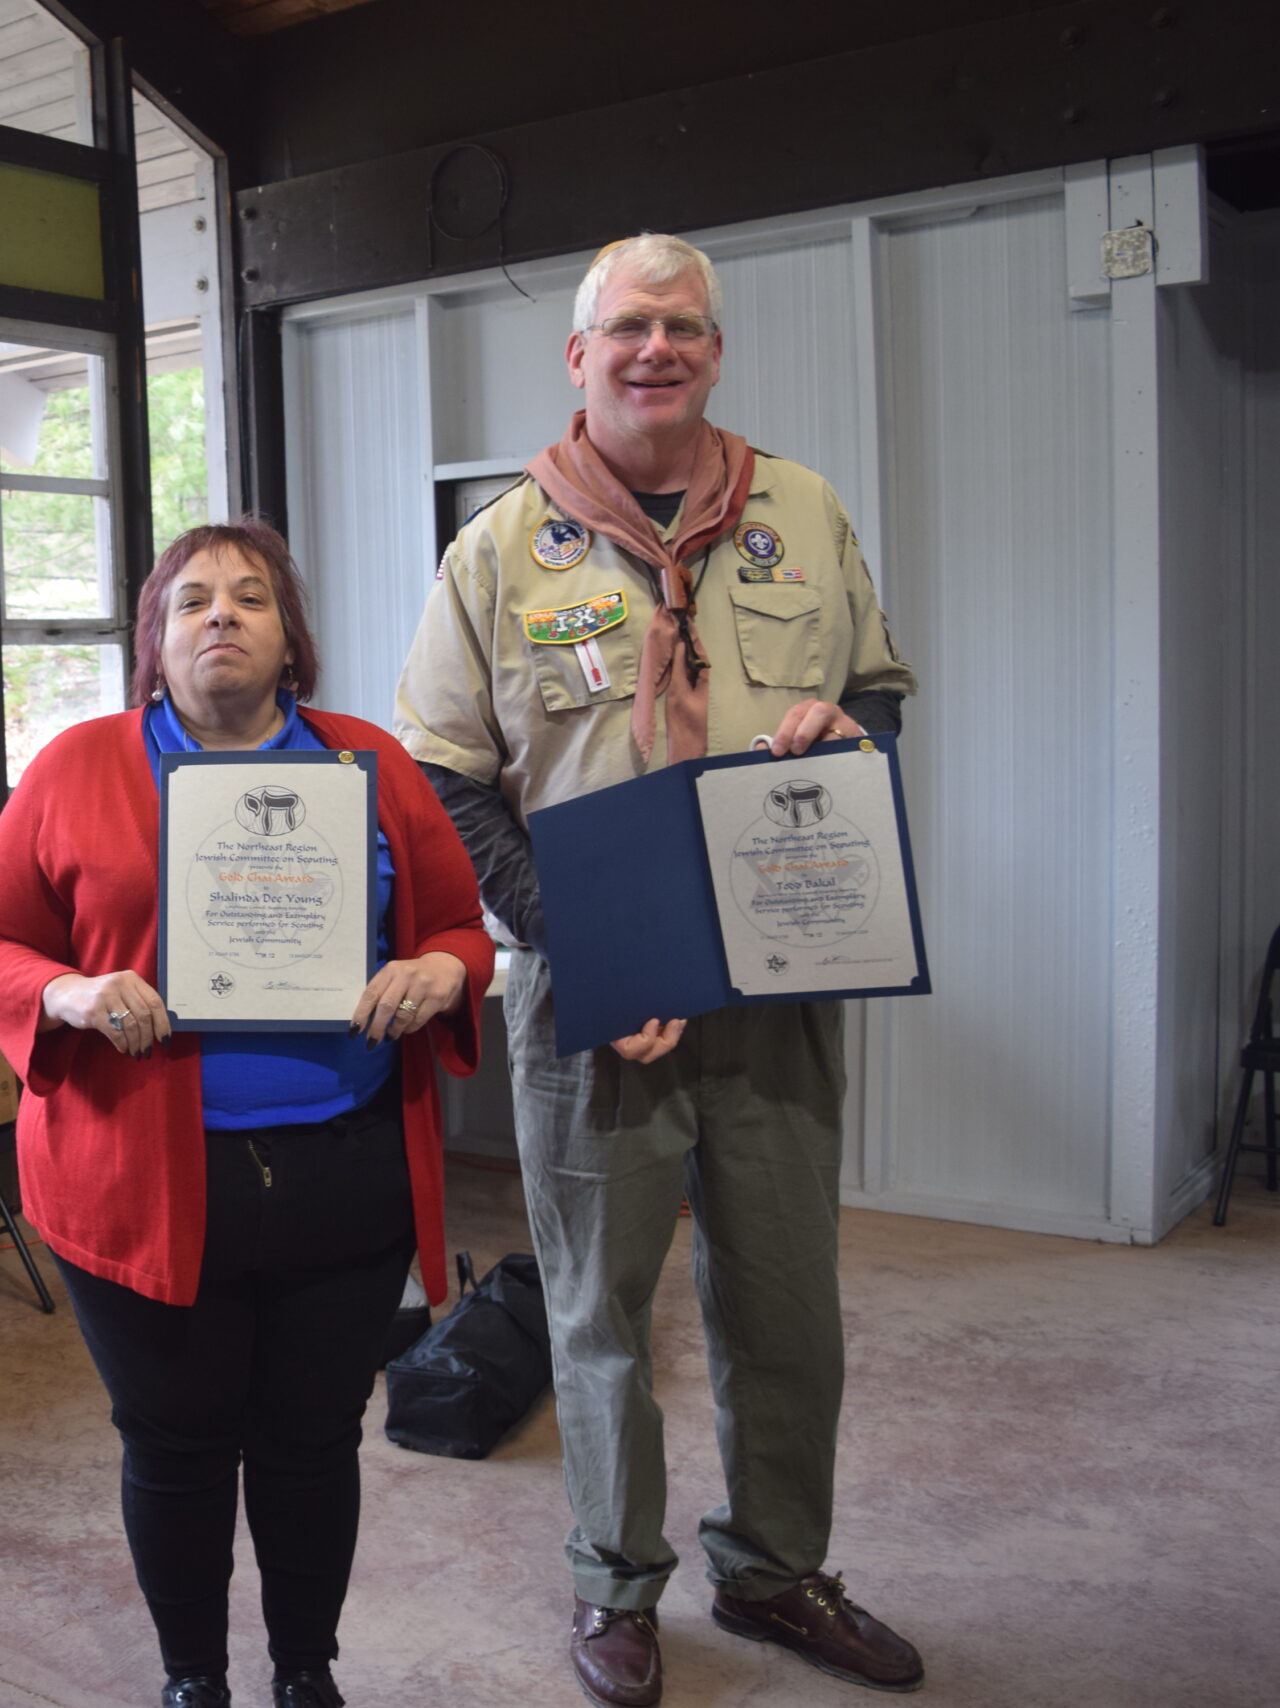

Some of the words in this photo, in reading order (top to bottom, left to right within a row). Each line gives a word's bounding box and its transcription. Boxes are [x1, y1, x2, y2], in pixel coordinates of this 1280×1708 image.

[752, 837, 769, 846] The
[816, 830, 849, 841] Region
[216, 841, 234, 851] The
[236, 842, 283, 852] Northeast
[285, 843, 318, 854] Region
[195, 853, 227, 863] Jewish
[229, 854, 280, 863] Committee
[282, 855, 295, 863] on
[297, 854, 338, 866] Scouting
[218, 872, 244, 882] Gold
[247, 872, 273, 882] Chai
[274, 872, 316, 884] Award
[209, 891, 260, 903] Shalinda
[285, 893, 323, 907] Young
[205, 910, 219, 918] For
[220, 910, 266, 920] Outstanding
[285, 912, 326, 921] Exemplary
[236, 920, 276, 928] performed
[278, 920, 289, 928] for
[291, 921, 325, 930] Scouting
[229, 936, 255, 945] Jewish
[255, 936, 302, 946] Community
